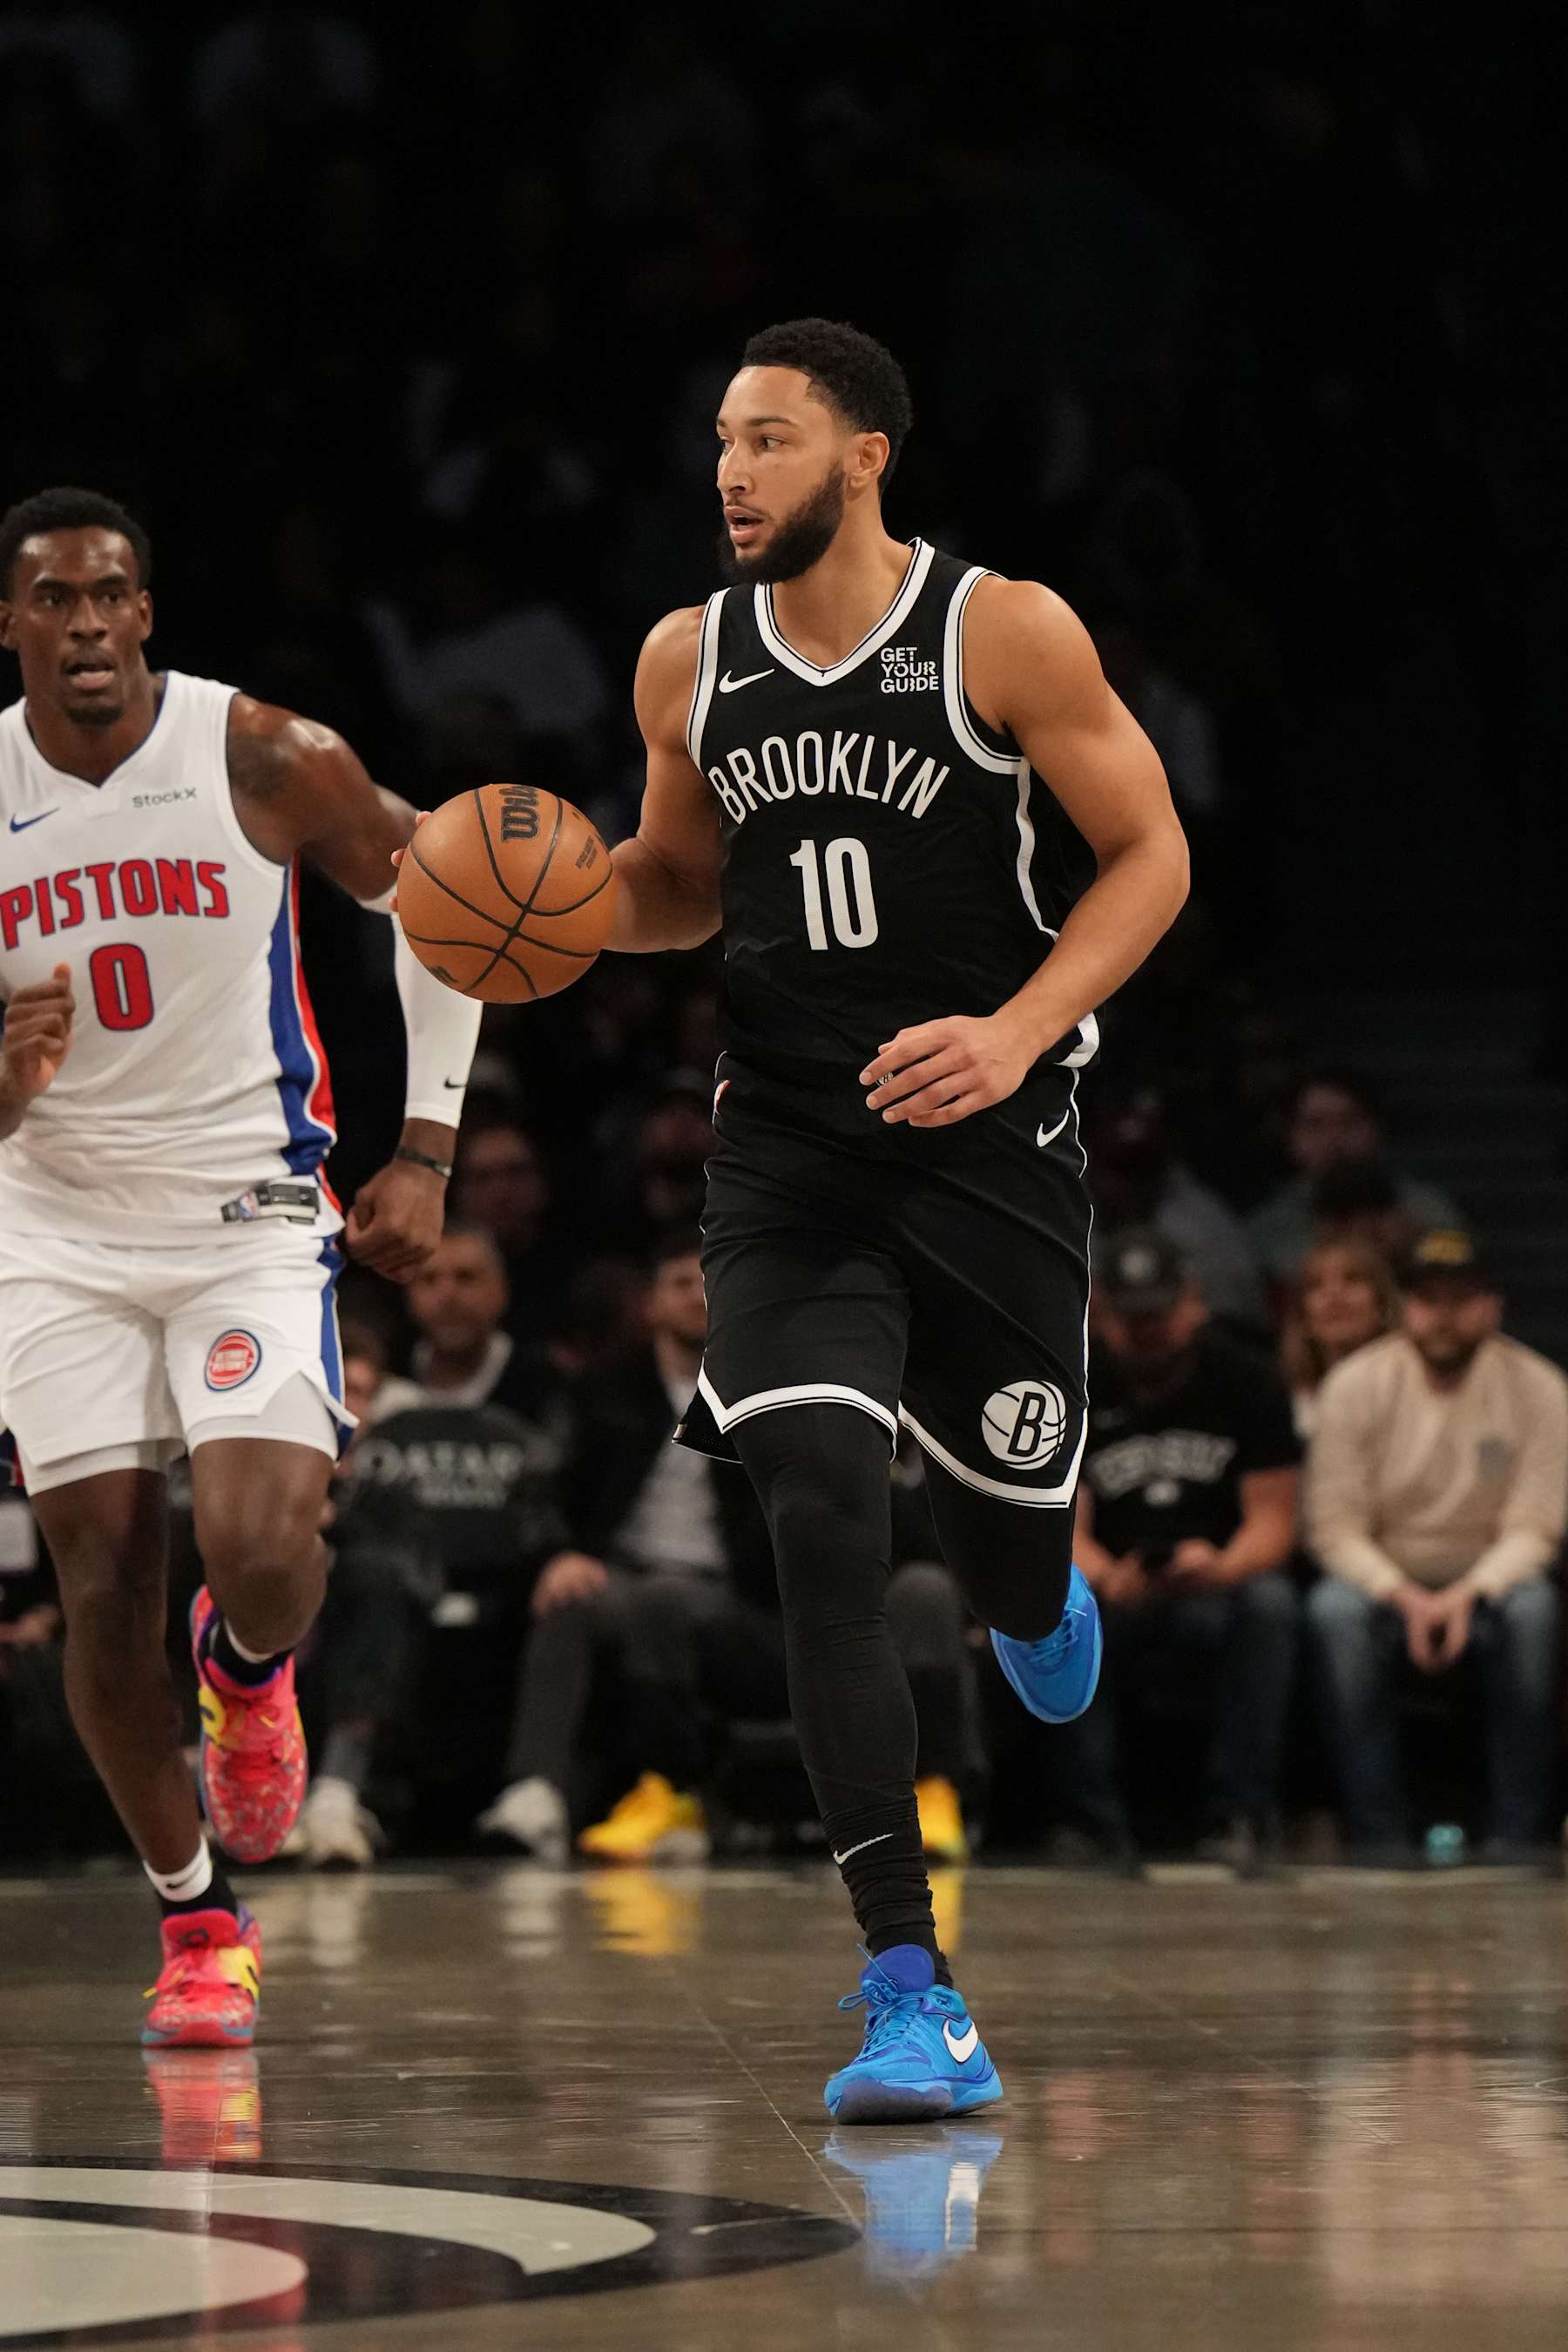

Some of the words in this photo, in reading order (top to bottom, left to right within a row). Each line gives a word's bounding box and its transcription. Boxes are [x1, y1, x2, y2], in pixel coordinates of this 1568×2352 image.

[880, 646, 917, 663] GET
[880, 661, 936, 678] YOUR
[880, 675, 939, 693] GUIDE
[132, 787, 197, 809] StockX
[707, 730, 950, 825] BROOKLYN
[0, 859, 230, 951] PISTONS
[789, 837, 879, 950] 10
[89, 943, 154, 1031] 0
